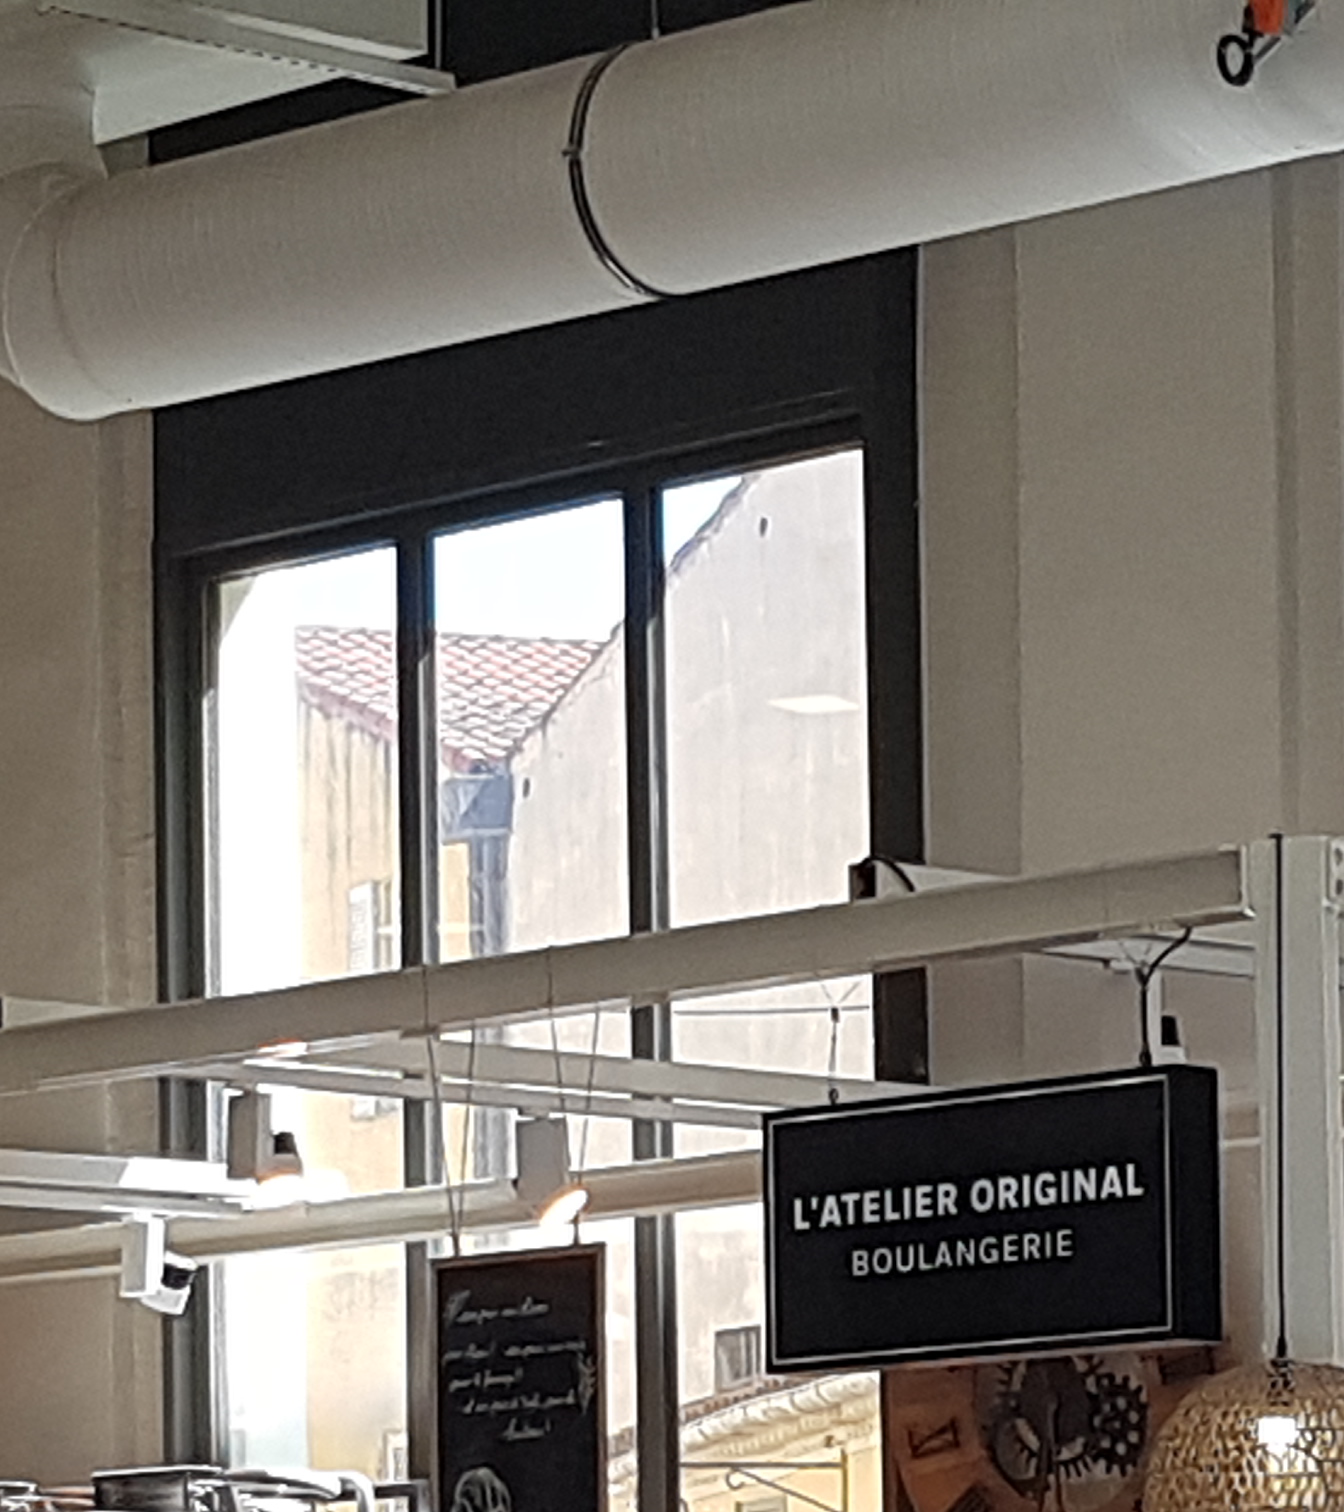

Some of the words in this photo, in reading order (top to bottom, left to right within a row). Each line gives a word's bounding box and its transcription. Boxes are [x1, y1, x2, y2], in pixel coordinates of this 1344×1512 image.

[792, 1181, 958, 1231] L'ATELIER
[969, 1163, 1145, 1213] ORIGINAL
[851, 1229, 1075, 1277] BOULANGERIE
